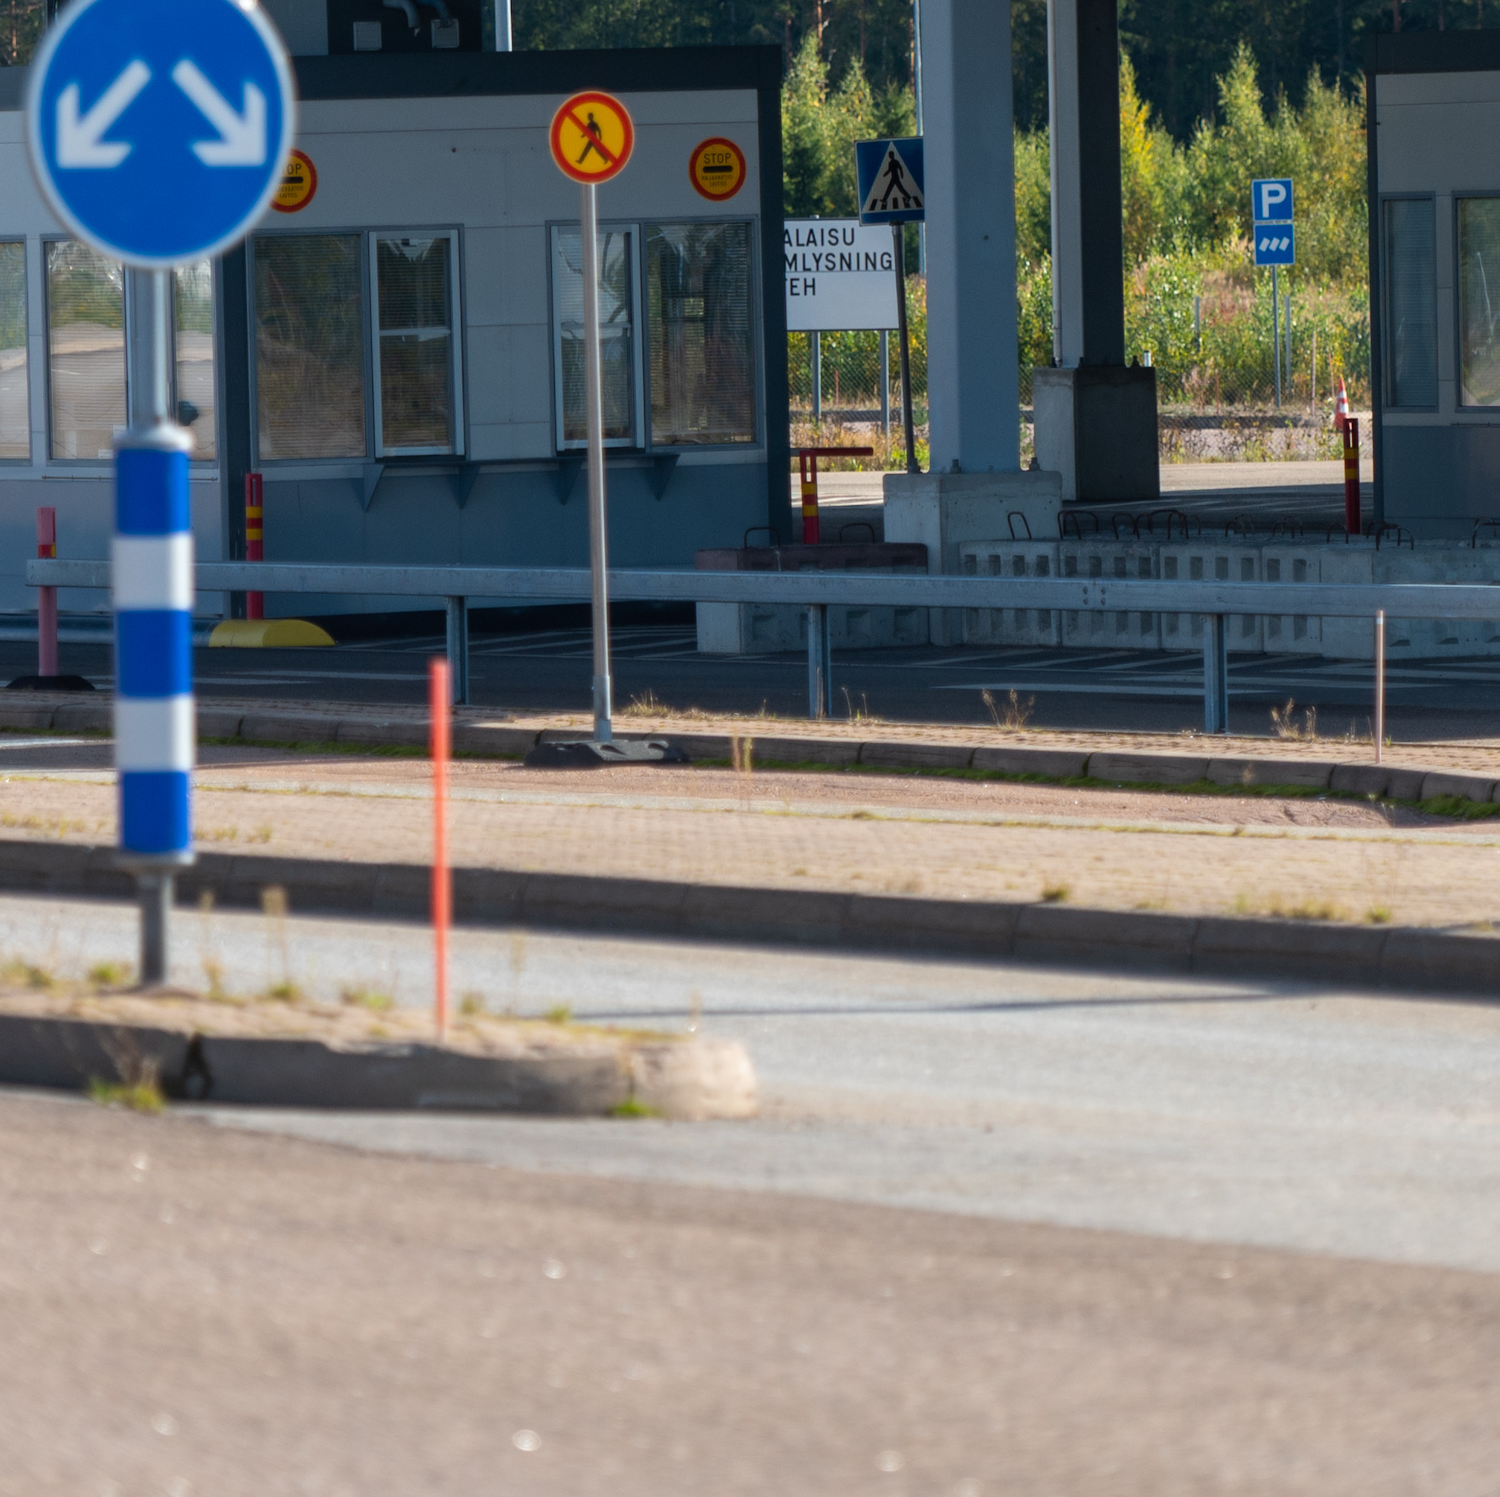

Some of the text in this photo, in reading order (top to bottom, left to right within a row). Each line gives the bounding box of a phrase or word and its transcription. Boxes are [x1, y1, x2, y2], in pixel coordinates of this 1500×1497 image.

[703, 153, 732, 164] STOP
[287, 163, 302, 175] OP
[1261, 183, 1286, 218] P
